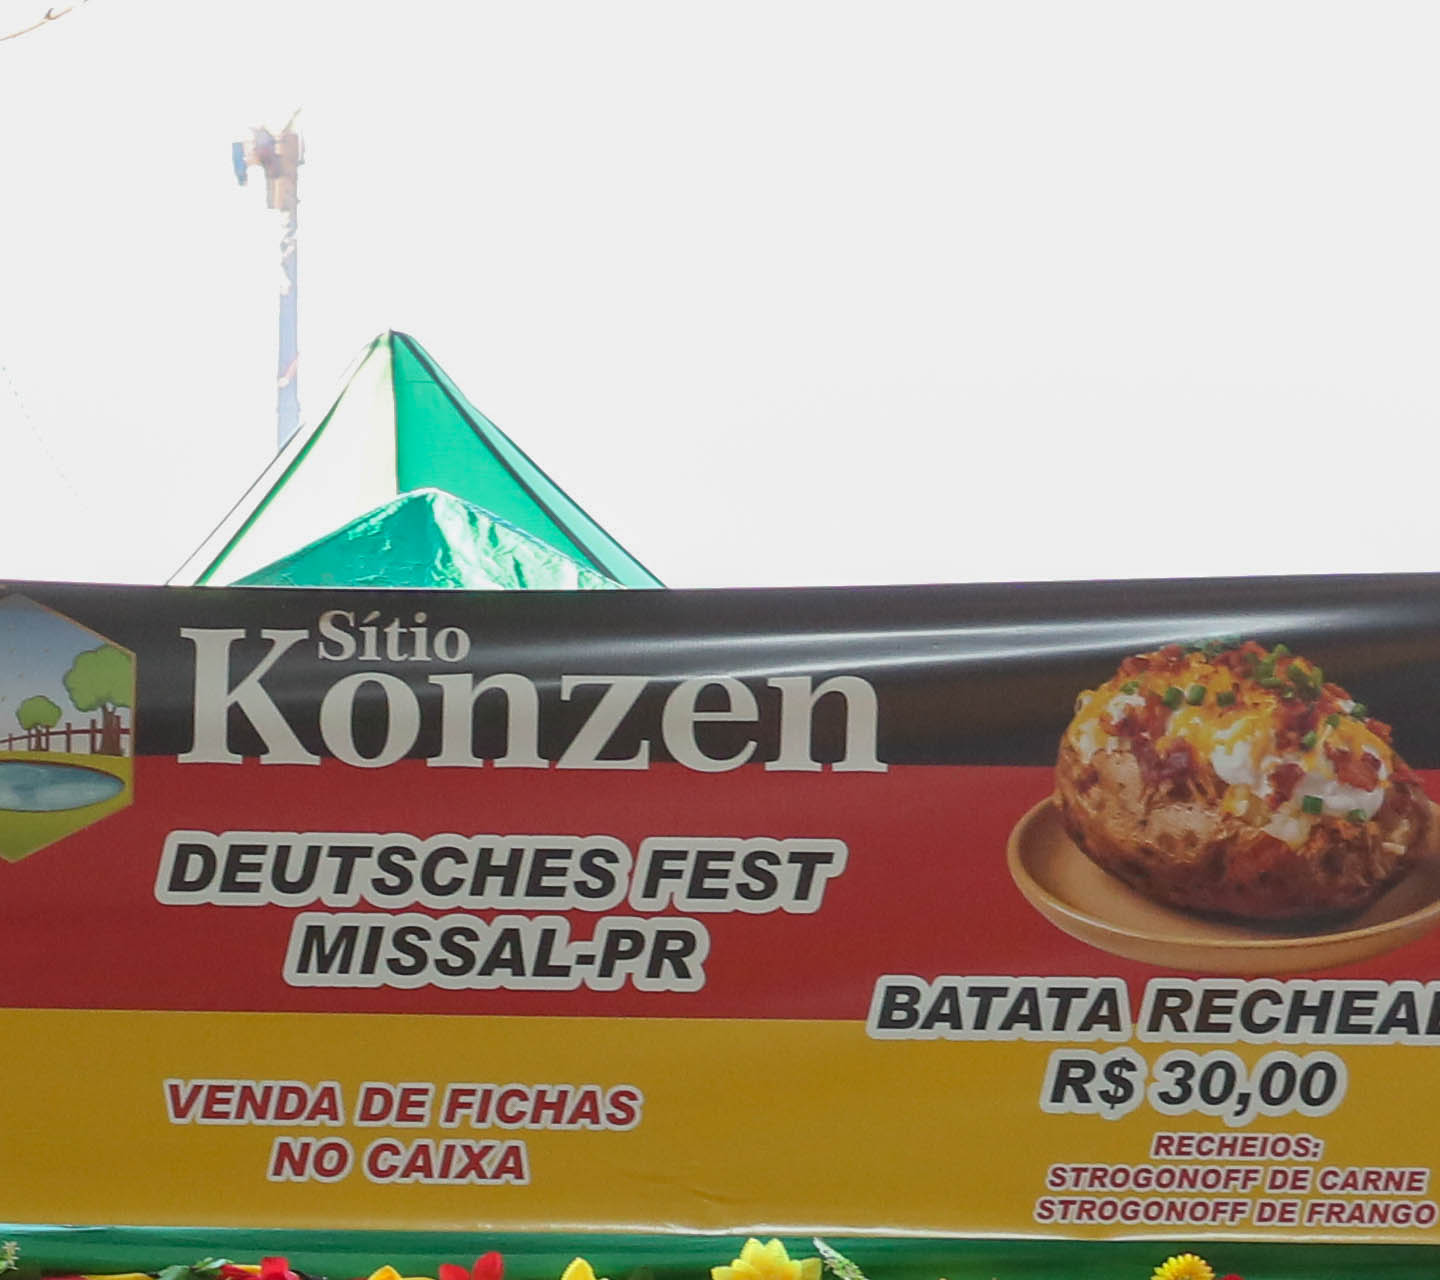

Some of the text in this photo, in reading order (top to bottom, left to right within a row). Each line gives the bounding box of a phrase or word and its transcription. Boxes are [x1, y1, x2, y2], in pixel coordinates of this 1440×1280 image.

[318, 609, 471, 664] Sítio
[177, 626, 889, 774] Konzen
[166, 842, 836, 902] DEUTSCHES FEST
[295, 924, 699, 981] MISSAL-PR
[876, 984, 1125, 1032] BATATA
[167, 1084, 639, 1127] VENDA DE FICHAS
[1050, 1056, 1338, 1118] R$ 30,00
[271, 1140, 526, 1182] NO CAIXA
[1152, 1135, 1321, 1159] RECHEIOS:
[1048, 1166, 1426, 1193] STROGONOFF DE CARNE
[1035, 1199, 1436, 1225] STROGONOFF DE FRANGO
